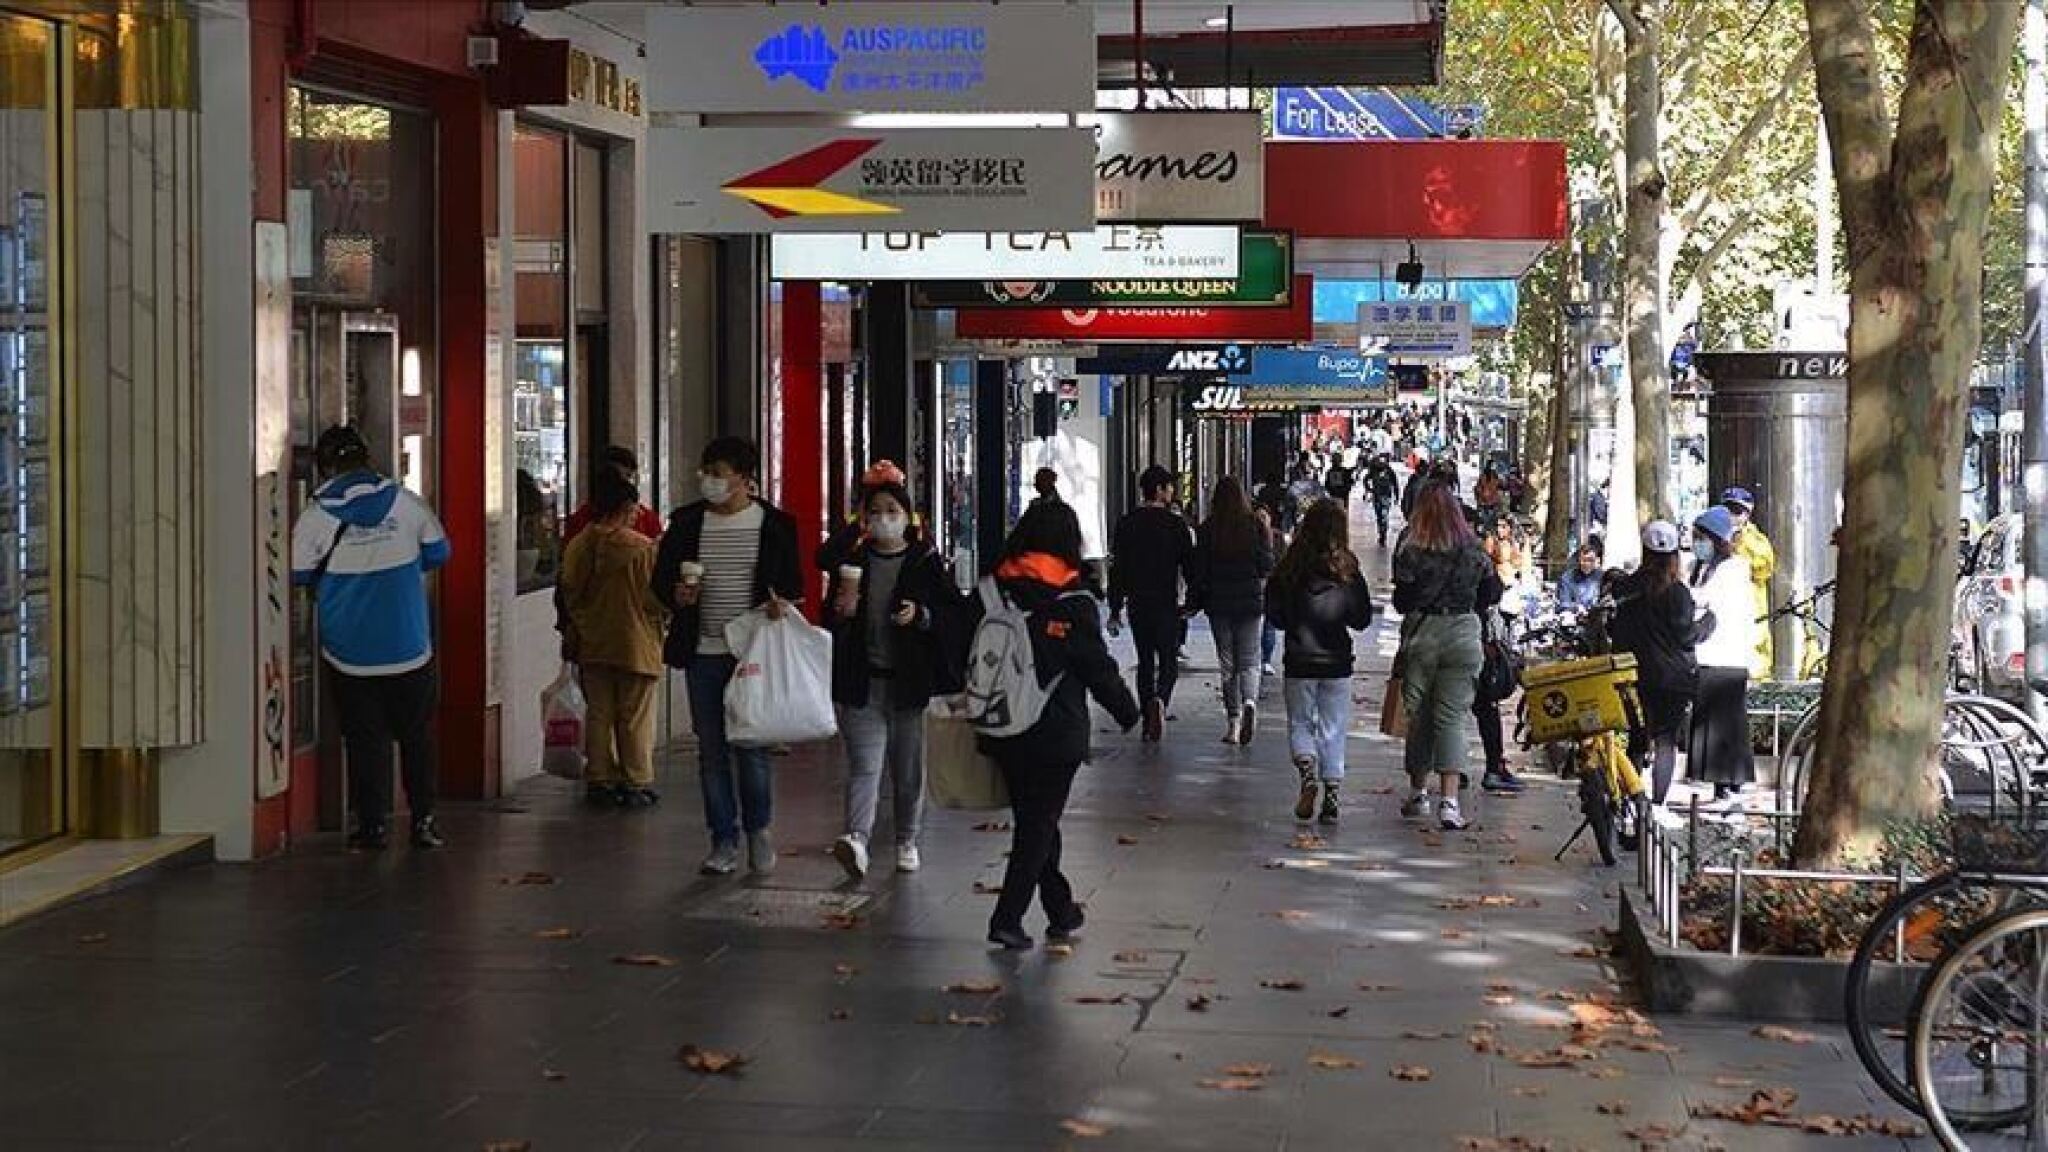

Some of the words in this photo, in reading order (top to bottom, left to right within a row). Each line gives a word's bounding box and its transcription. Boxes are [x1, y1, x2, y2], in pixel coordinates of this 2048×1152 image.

[842, 27, 986, 50] AUSPACIFIC
[1286, 97, 1318, 129] For
[1325, 105, 1379, 135] Lease
[861, 158, 1026, 186] 领英留学移民
[1166, 350, 1220, 371] ANZ
[1317, 353, 1360, 371] Bupa
